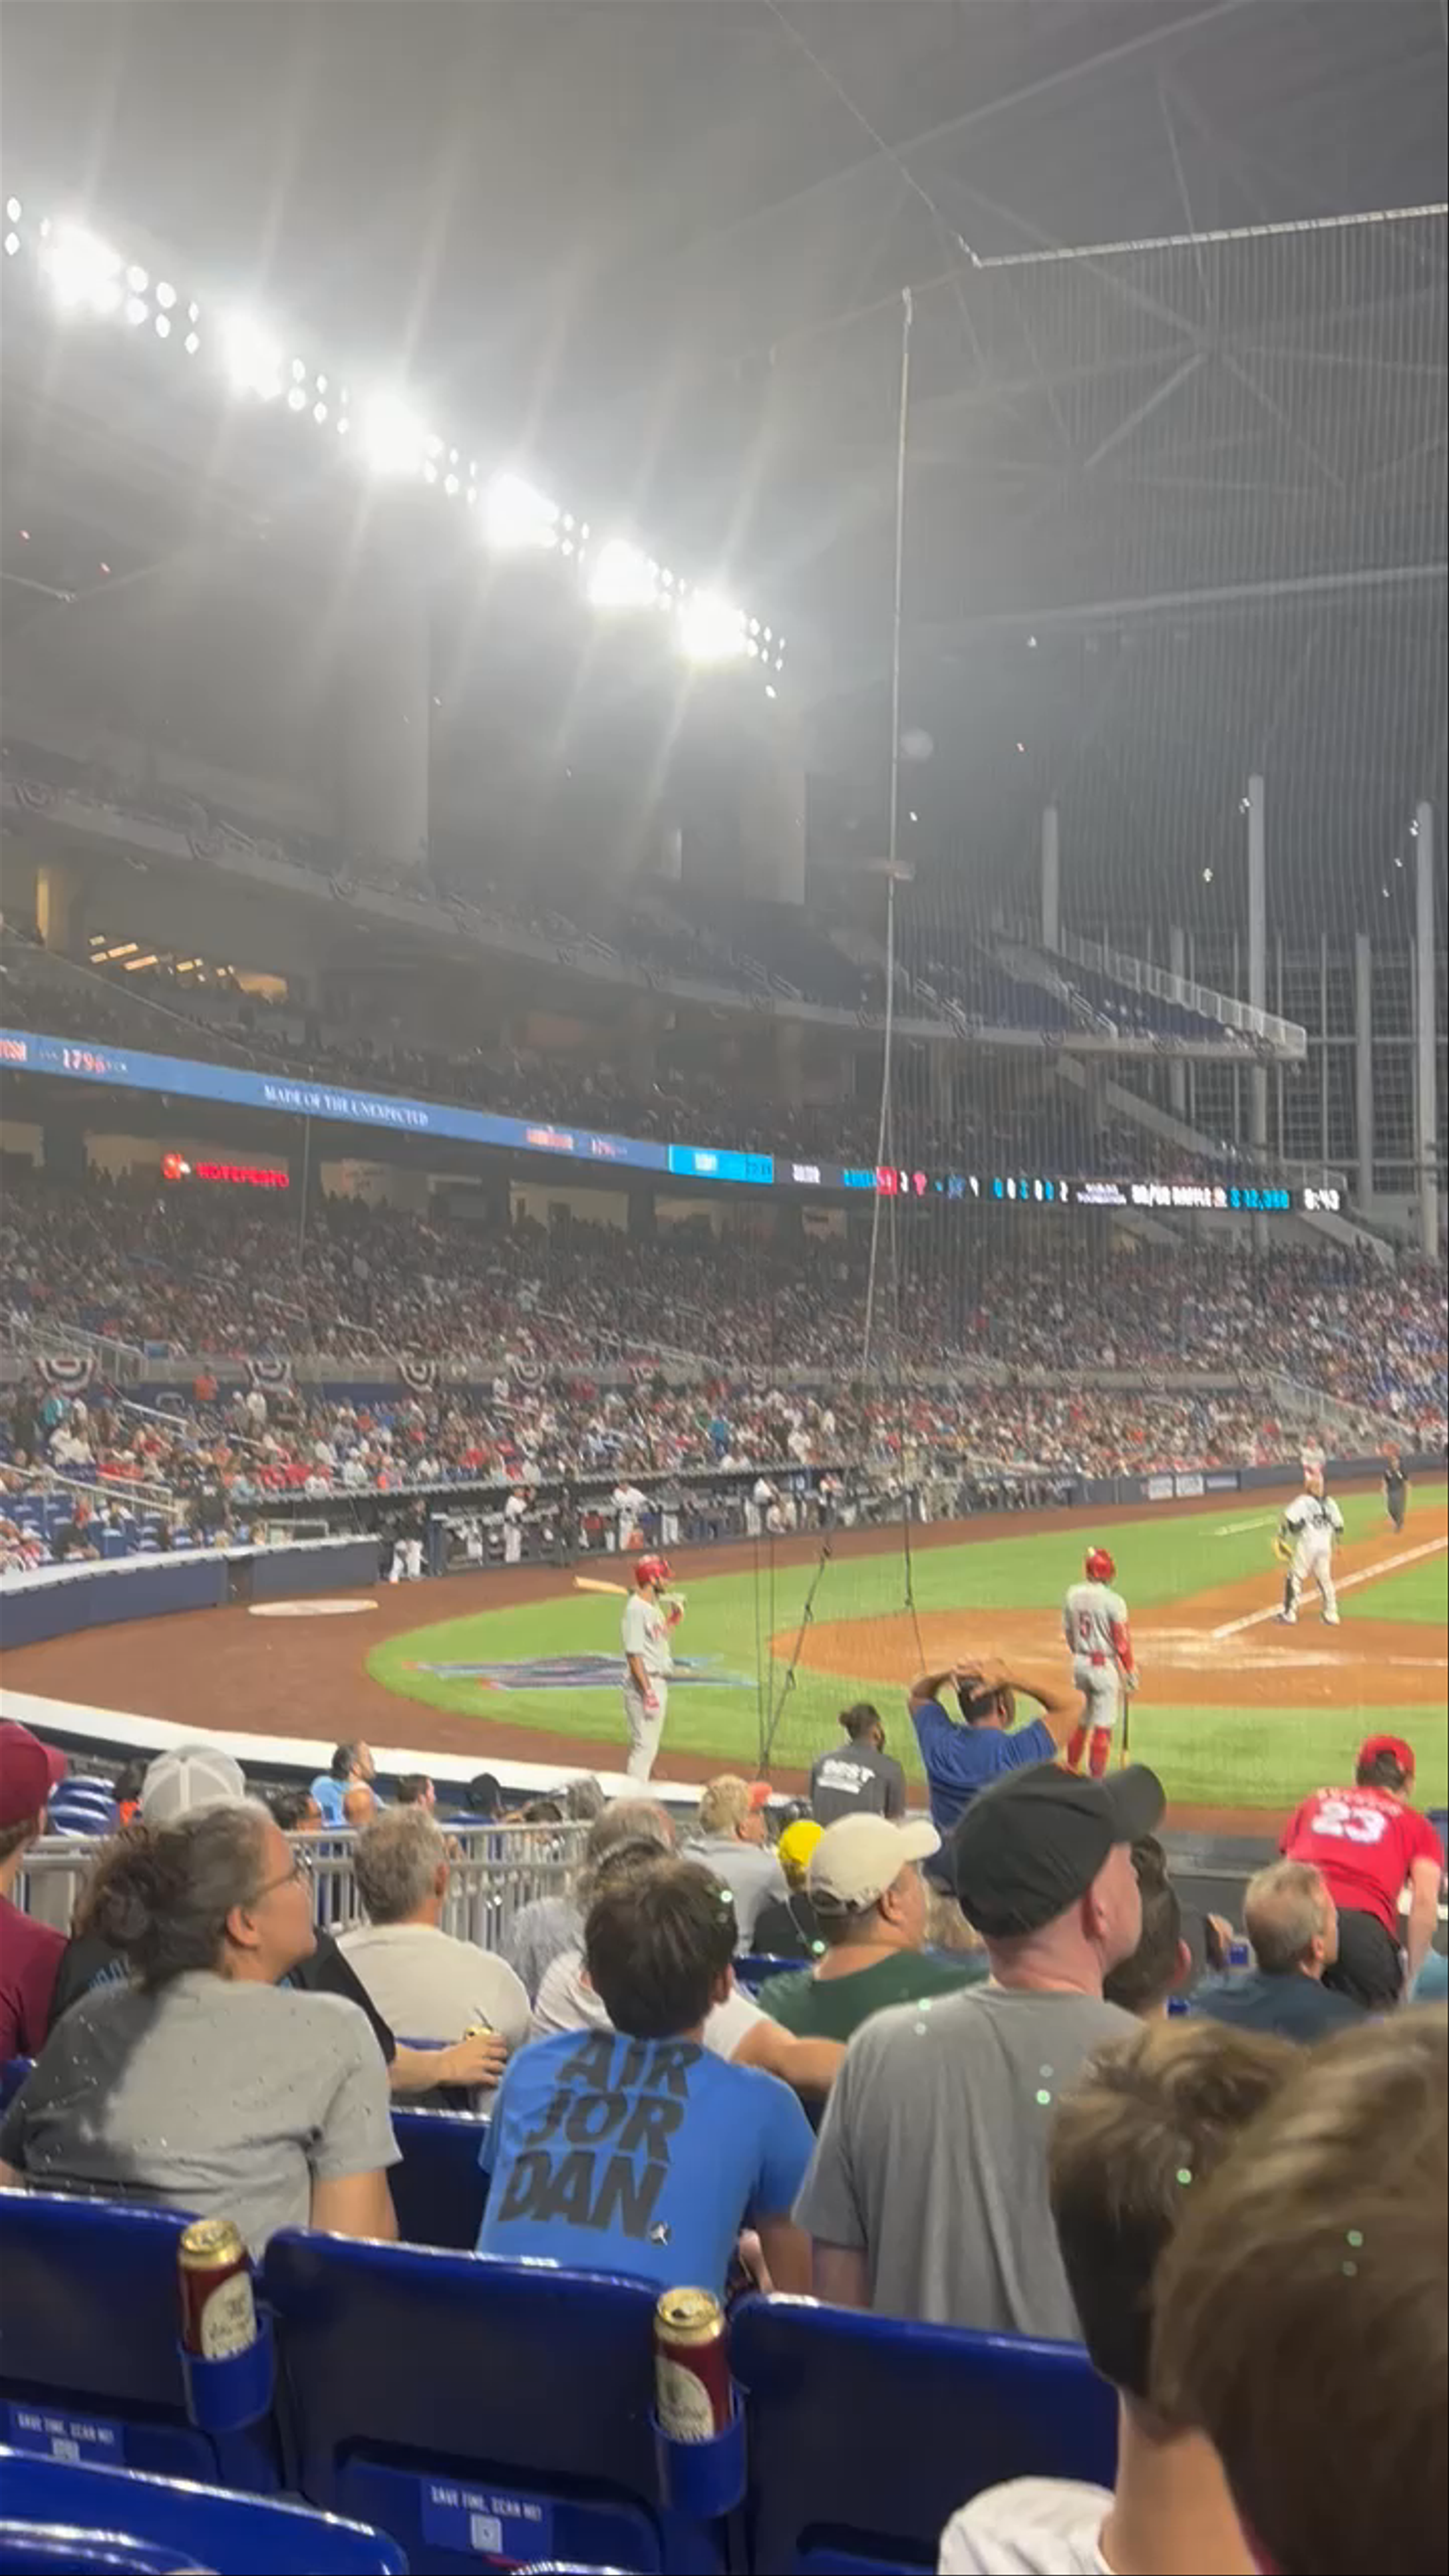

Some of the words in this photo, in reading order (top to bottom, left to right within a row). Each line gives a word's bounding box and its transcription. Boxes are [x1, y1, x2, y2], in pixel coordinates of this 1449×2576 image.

[265, 1084, 300, 1104] MADE
[304, 1093, 320, 1109] OF
[323, 1094, 348, 1113] THE
[351, 1098, 429, 1127] UNEXPECTED
[1311, 1801, 1387, 1844] 23
[555, 2029, 702, 2098] AIR
[526, 2088, 685, 2162] JOR
[498, 2149, 667, 2241] DAN
